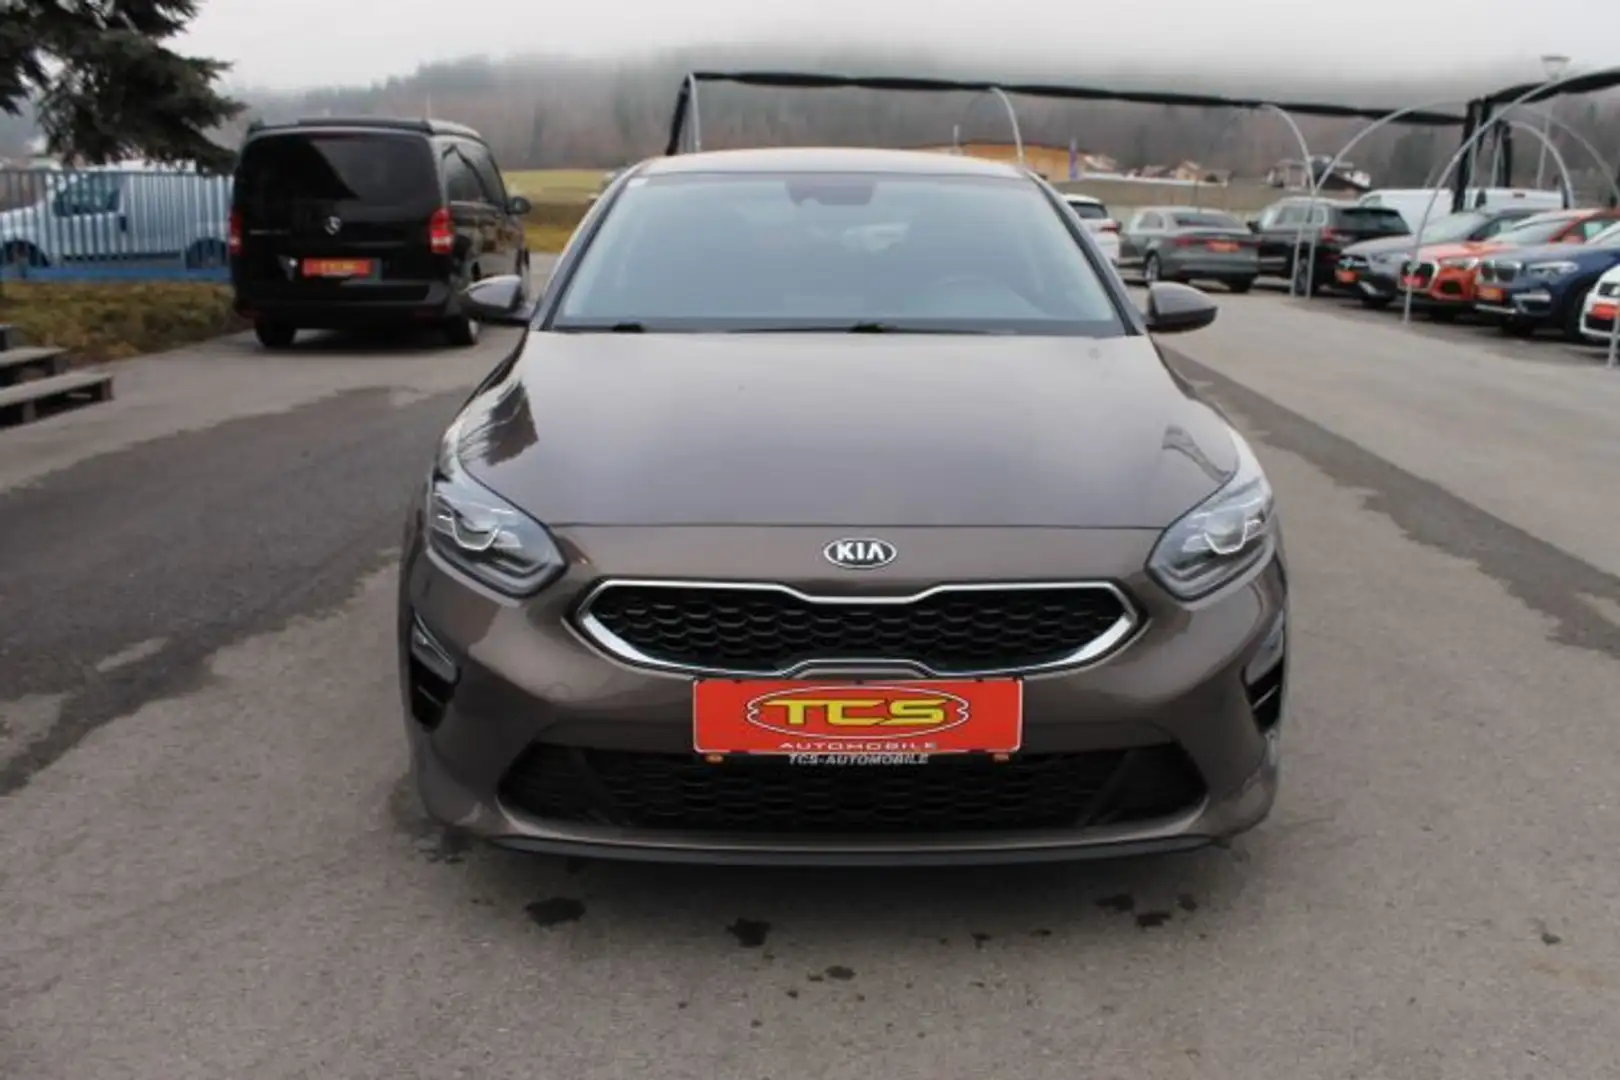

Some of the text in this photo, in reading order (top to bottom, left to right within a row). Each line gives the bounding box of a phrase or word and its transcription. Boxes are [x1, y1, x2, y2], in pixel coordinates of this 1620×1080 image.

[837, 542, 885, 560] KIA
[762, 699, 950, 726] TCS
[779, 742, 937, 750] AUTOMOBILE
[788, 753, 929, 765] TCS-AUTOMOBILE
